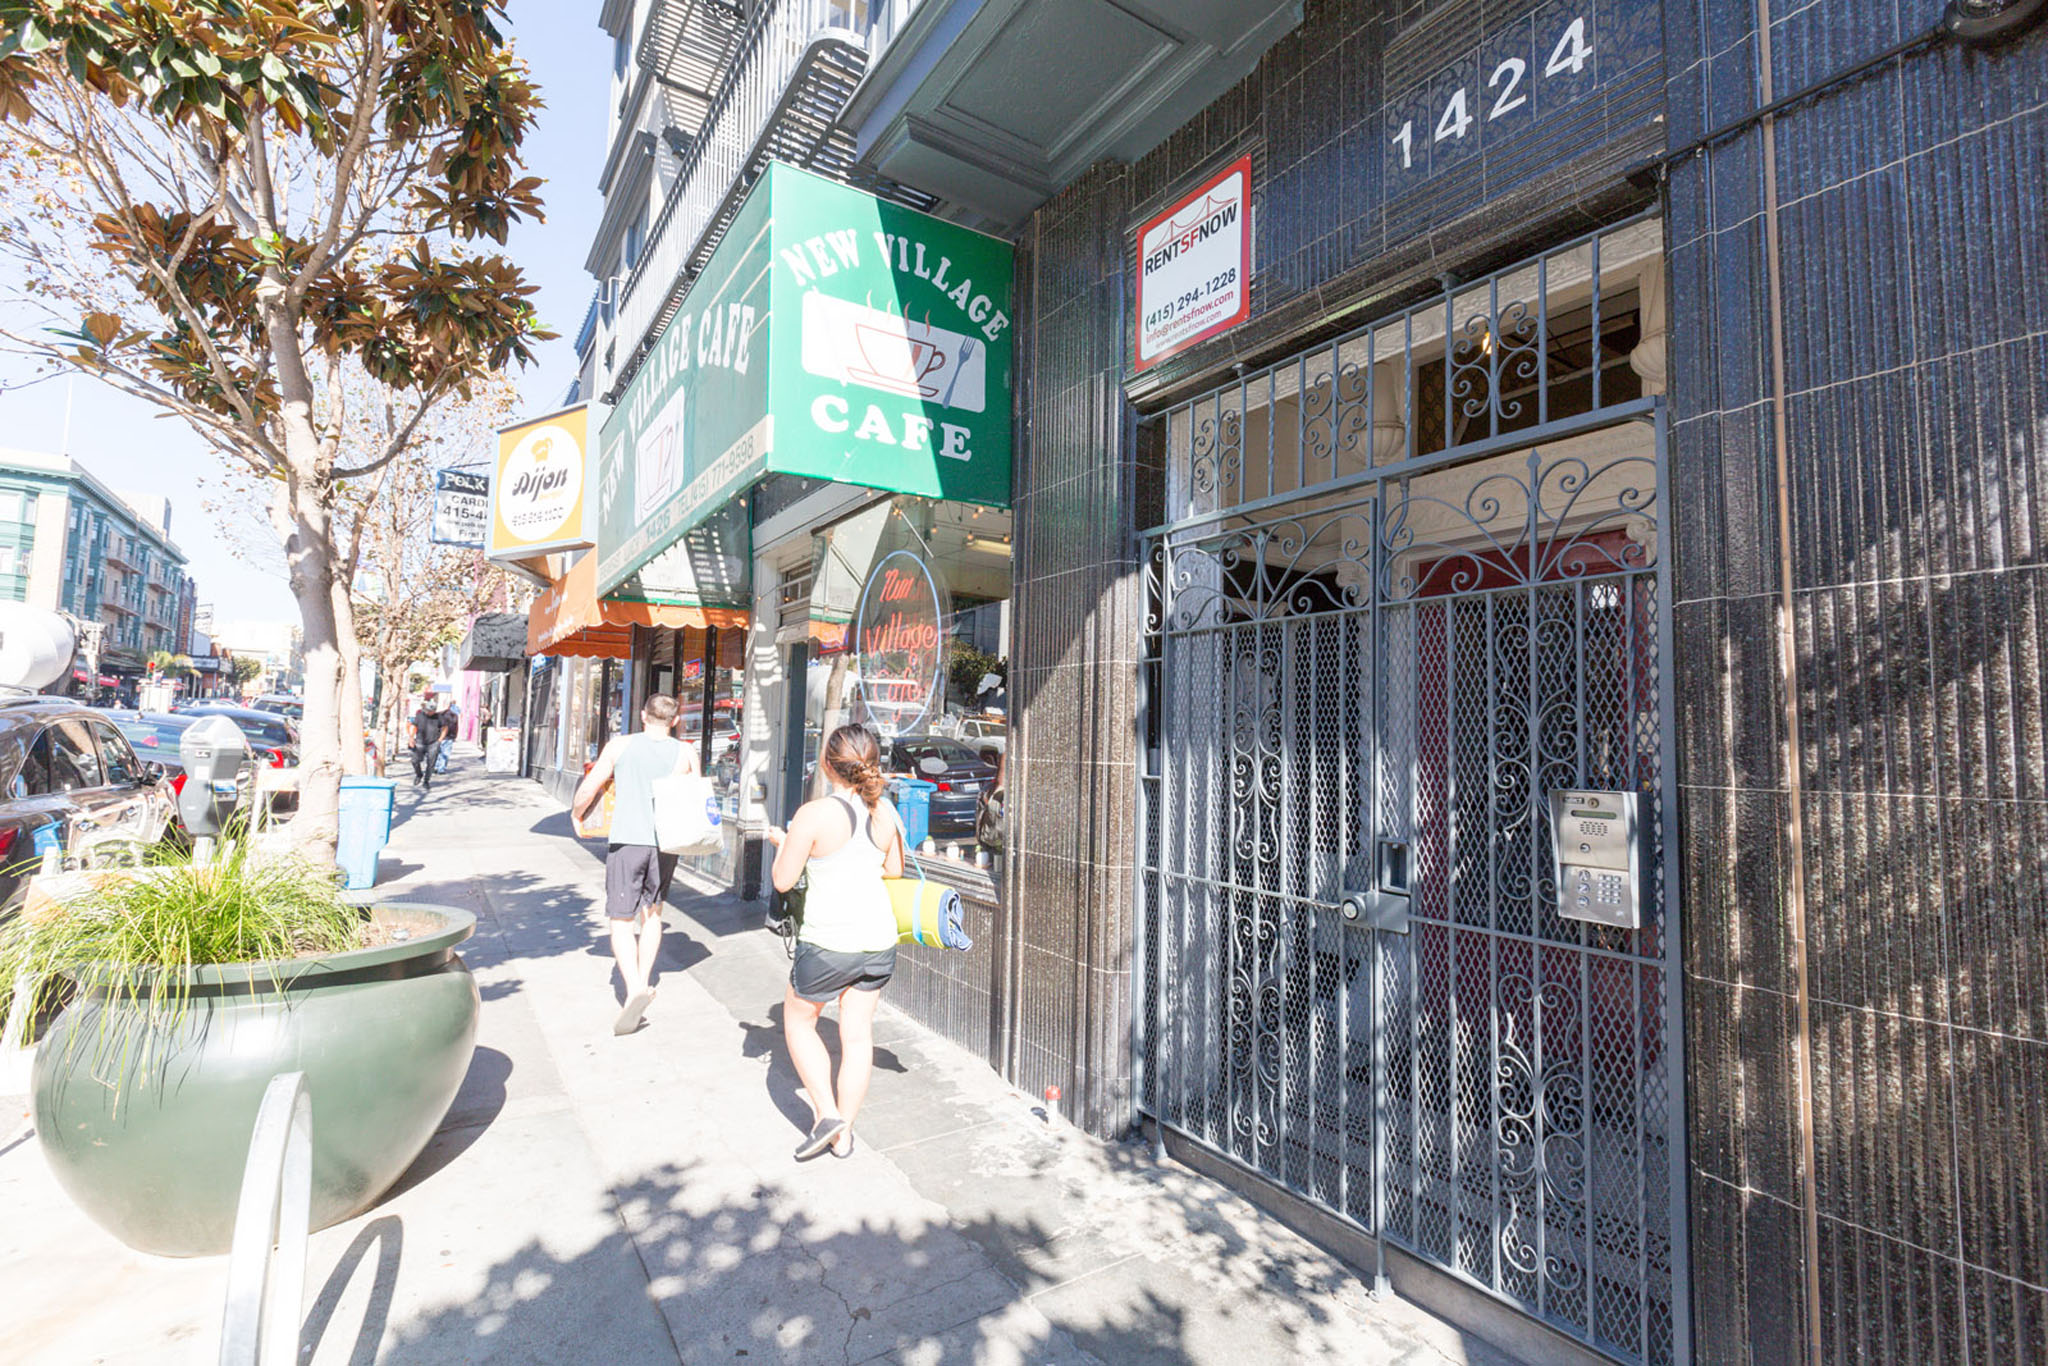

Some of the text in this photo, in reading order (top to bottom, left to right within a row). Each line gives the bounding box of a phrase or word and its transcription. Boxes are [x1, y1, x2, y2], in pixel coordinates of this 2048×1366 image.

[1391, 16, 1593, 170] 1424
[1144, 202, 1238, 277] RENTSFNOW
[780, 228, 1010, 343] NEW VILLAGE
[1145, 267, 1236, 332] (415) 294-1228
[1145, 289, 1235, 345] info@rentsfnow.com
[602, 429, 625, 527] NEW
[628, 313, 692, 444] VILLAGE
[697, 303, 756, 375] CAFE
[810, 394, 973, 463] CAFE
[441, 472, 486, 491] POLK
[511, 465, 569, 502] Dijon
[865, 611, 938, 666] Village
